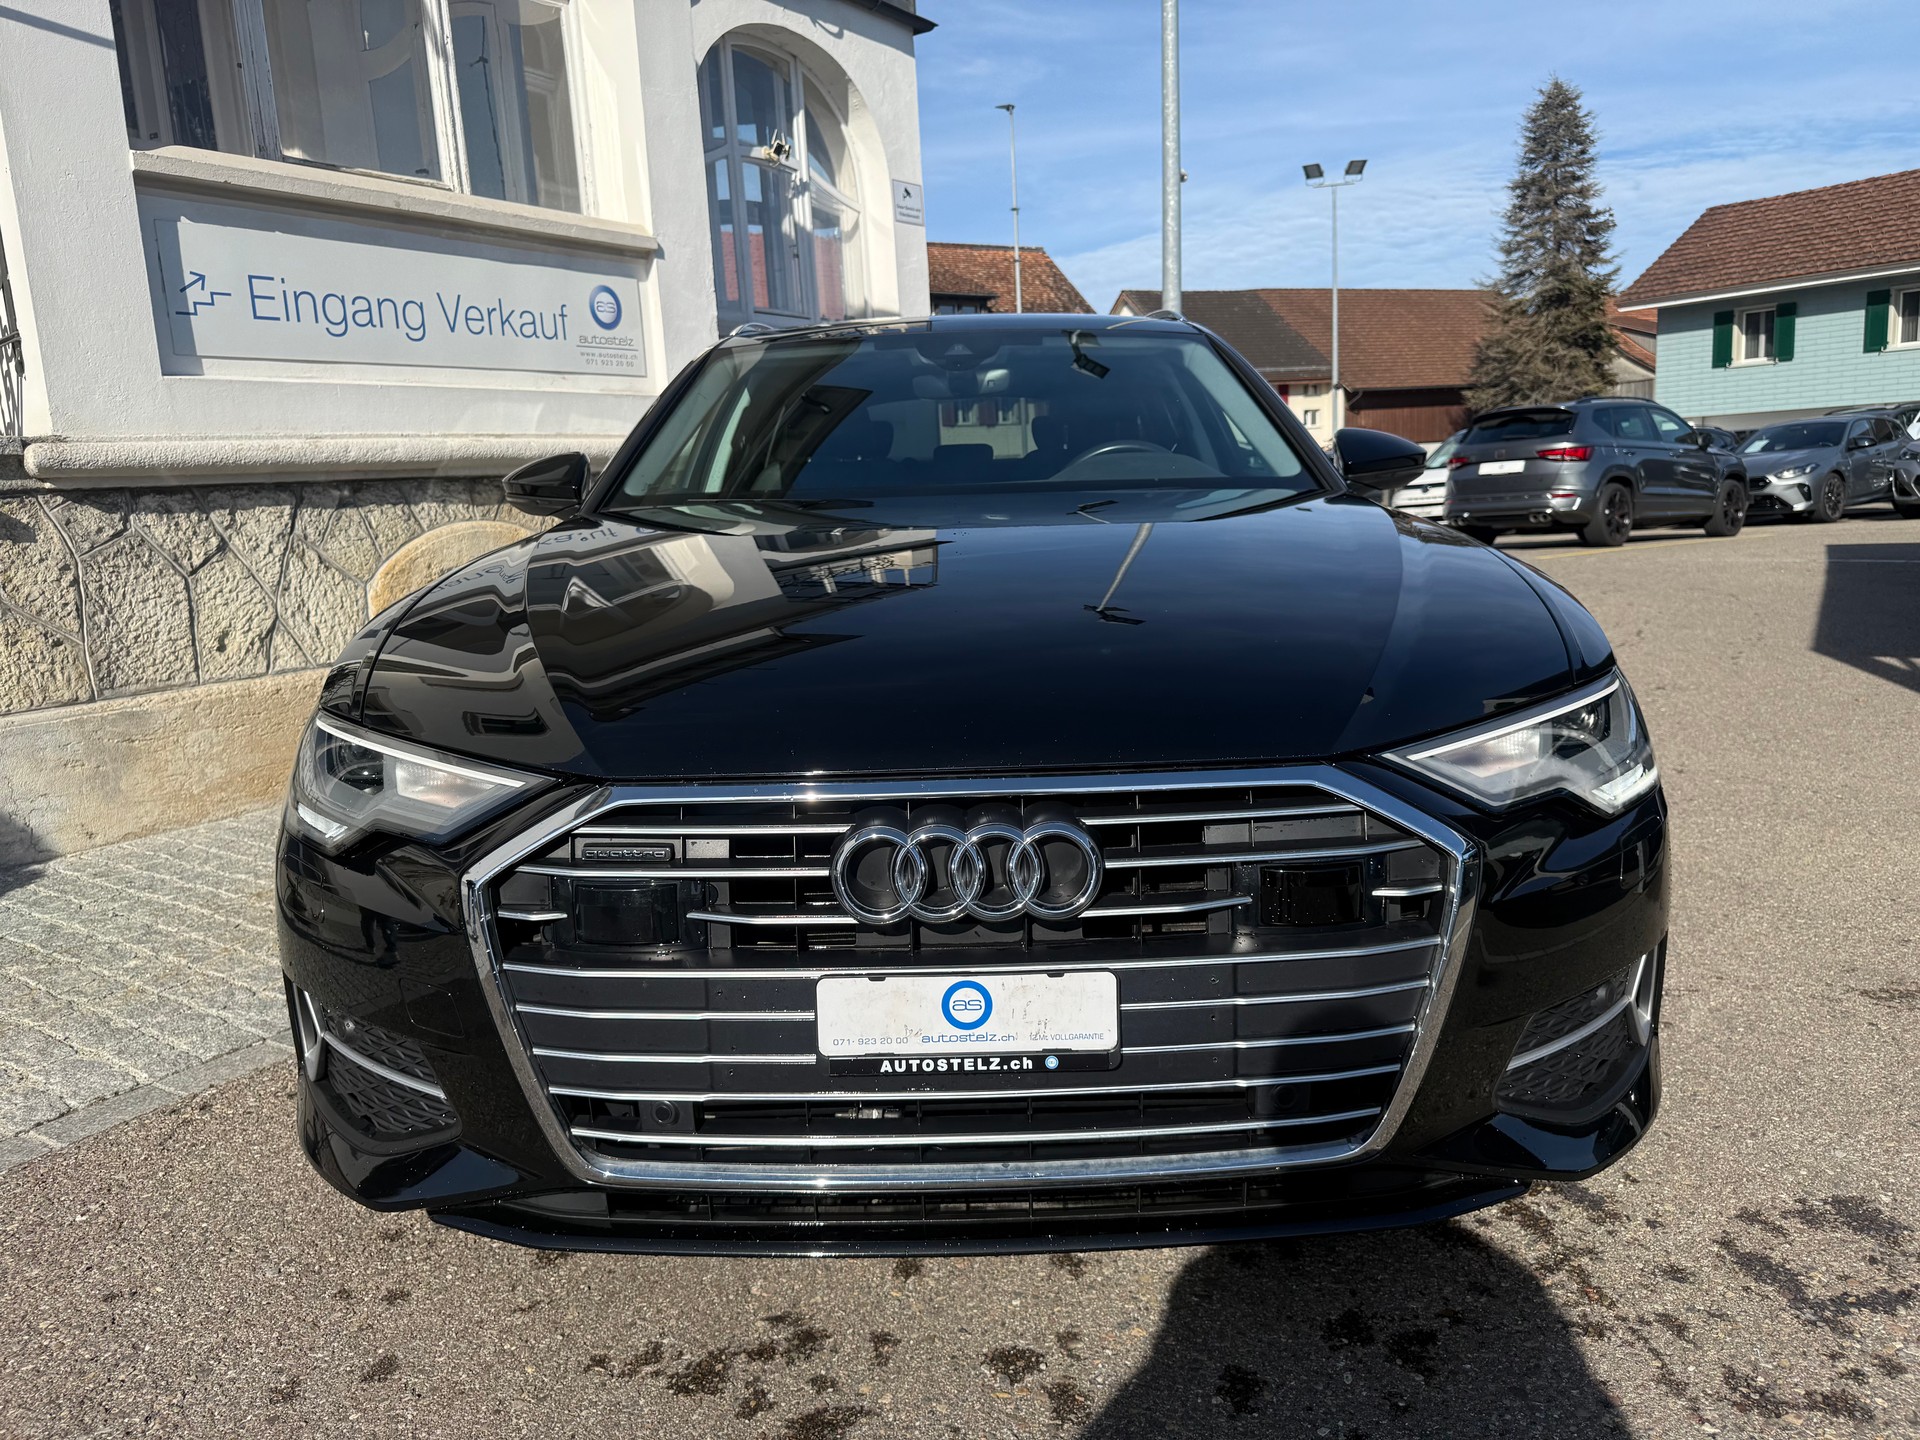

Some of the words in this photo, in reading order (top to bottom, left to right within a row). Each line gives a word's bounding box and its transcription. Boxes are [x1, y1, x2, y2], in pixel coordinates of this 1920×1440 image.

[247, 274, 426, 342] Eingang
[436, 291, 568, 341] Verkauf
[578, 335, 635, 346] autostelz
[580, 352, 638, 360] www.autostelz.ch
[952, 999, 983, 1012] as
[857, 1037, 877, 1046] 923
[879, 1037, 893, 1045] 20
[895, 1036, 909, 1045] 00
[921, 1032, 1015, 1043] autostelz.ch
[1050, 1032, 1105, 1041] VOLLGARANTIE
[880, 1057, 1033, 1073] AUTOSTELZ.ch
